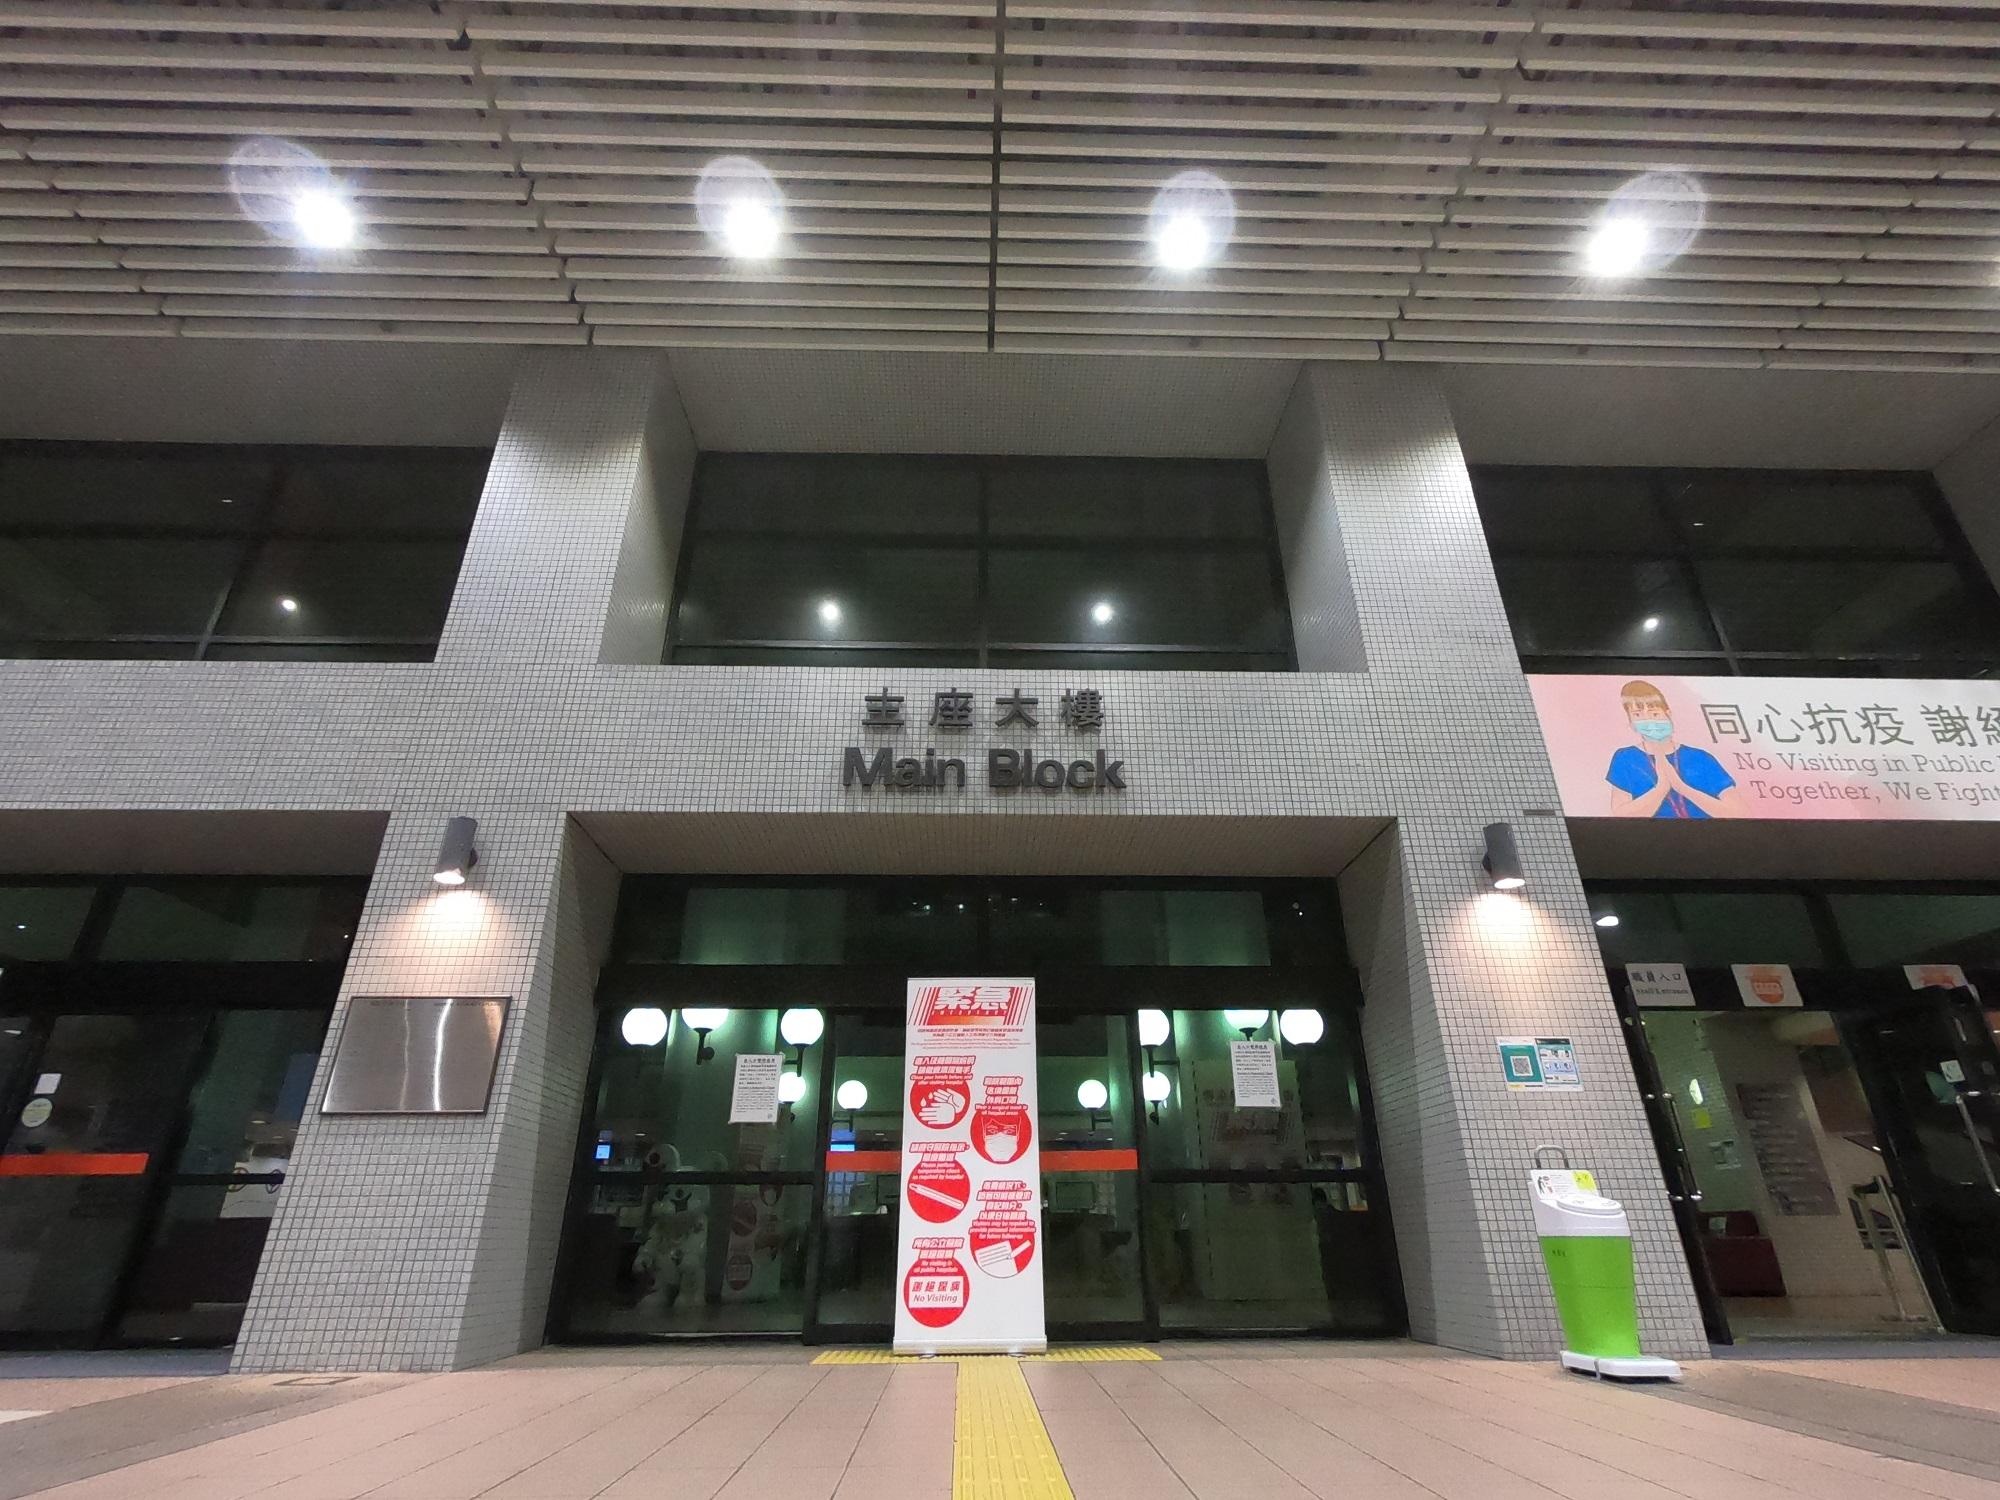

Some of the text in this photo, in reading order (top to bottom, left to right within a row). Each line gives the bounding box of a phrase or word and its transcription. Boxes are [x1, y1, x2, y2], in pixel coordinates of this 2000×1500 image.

[862, 686, 1104, 729] 主座大樓
[1701, 703, 1914, 745] 同心抗疫
[842, 747, 1127, 789] Main Block
[1733, 752, 1995, 776] No Visiting in Public
[1750, 781, 1881, 804] Together,
[1882, 782, 1932, 800] We
[914, 1294, 958, 1303] No Visiting
